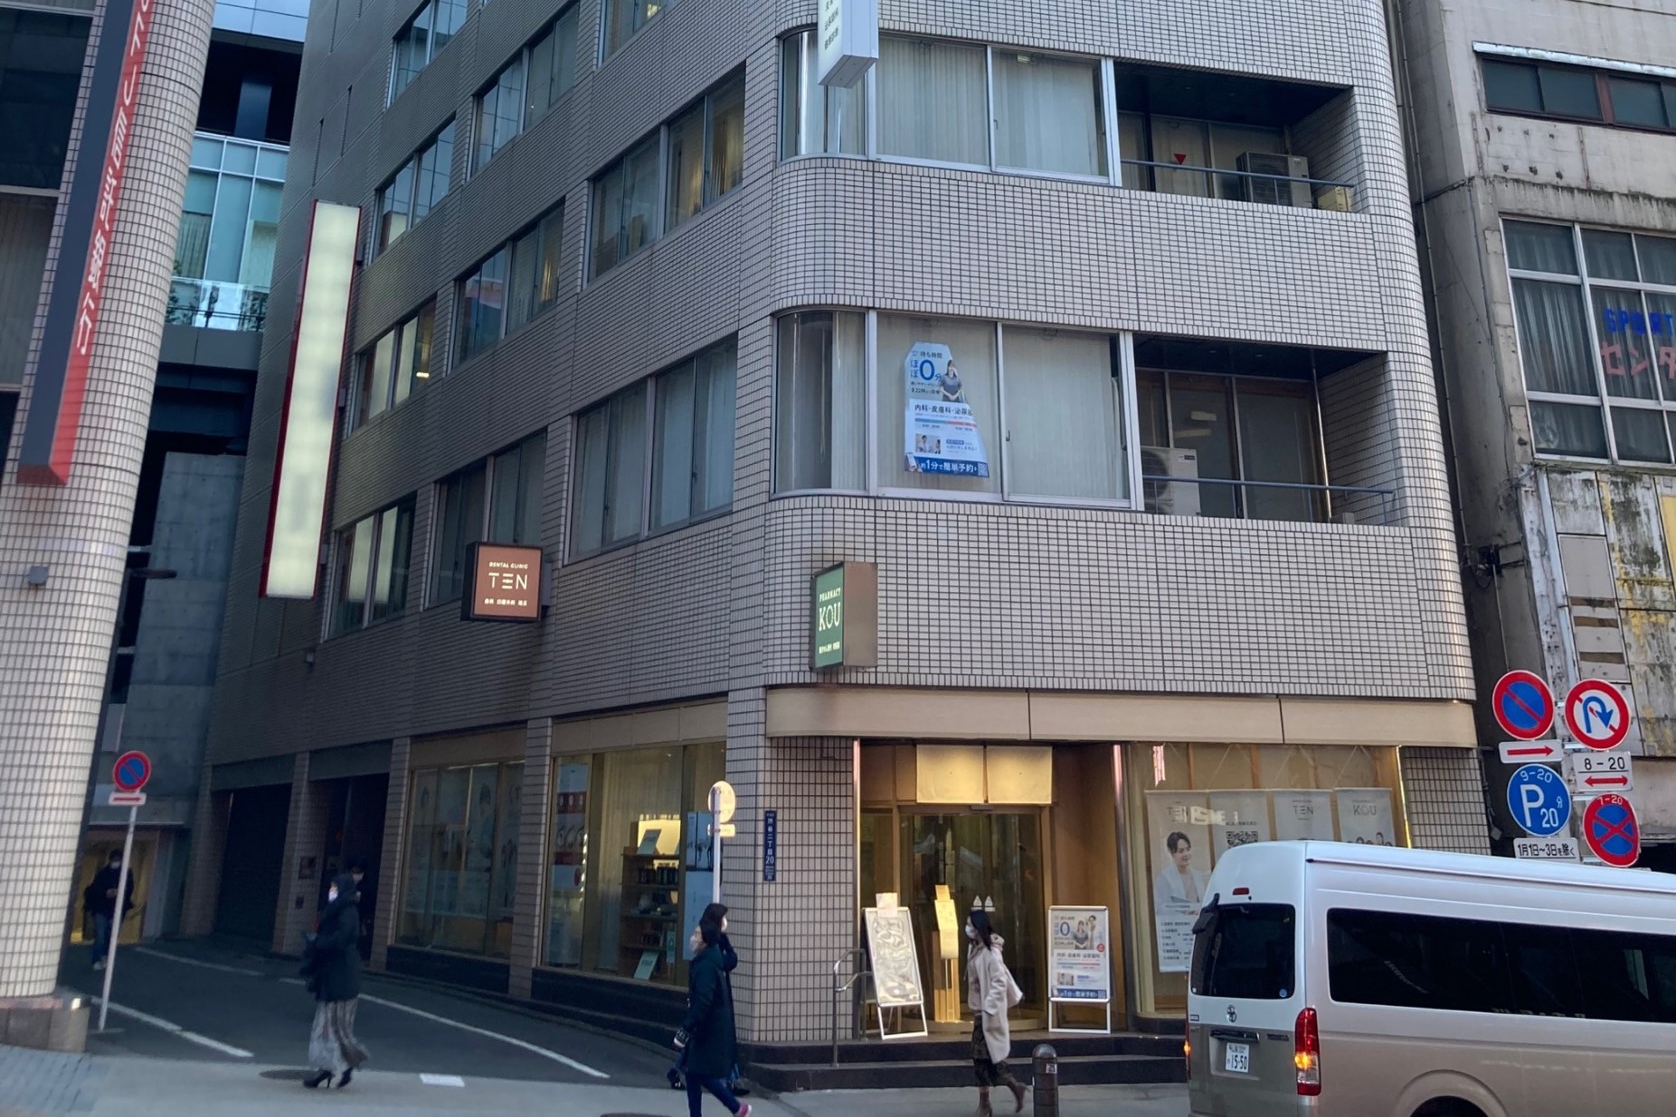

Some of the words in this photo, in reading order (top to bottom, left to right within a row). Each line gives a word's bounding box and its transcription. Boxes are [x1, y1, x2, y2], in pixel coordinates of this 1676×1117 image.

[488, 572, 528, 590] TEN
[819, 602, 841, 632] KOU
[1519, 768, 1553, 783] 9-20
[1353, 804, 1377, 816] KOU
[1520, 783, 1545, 828] P
